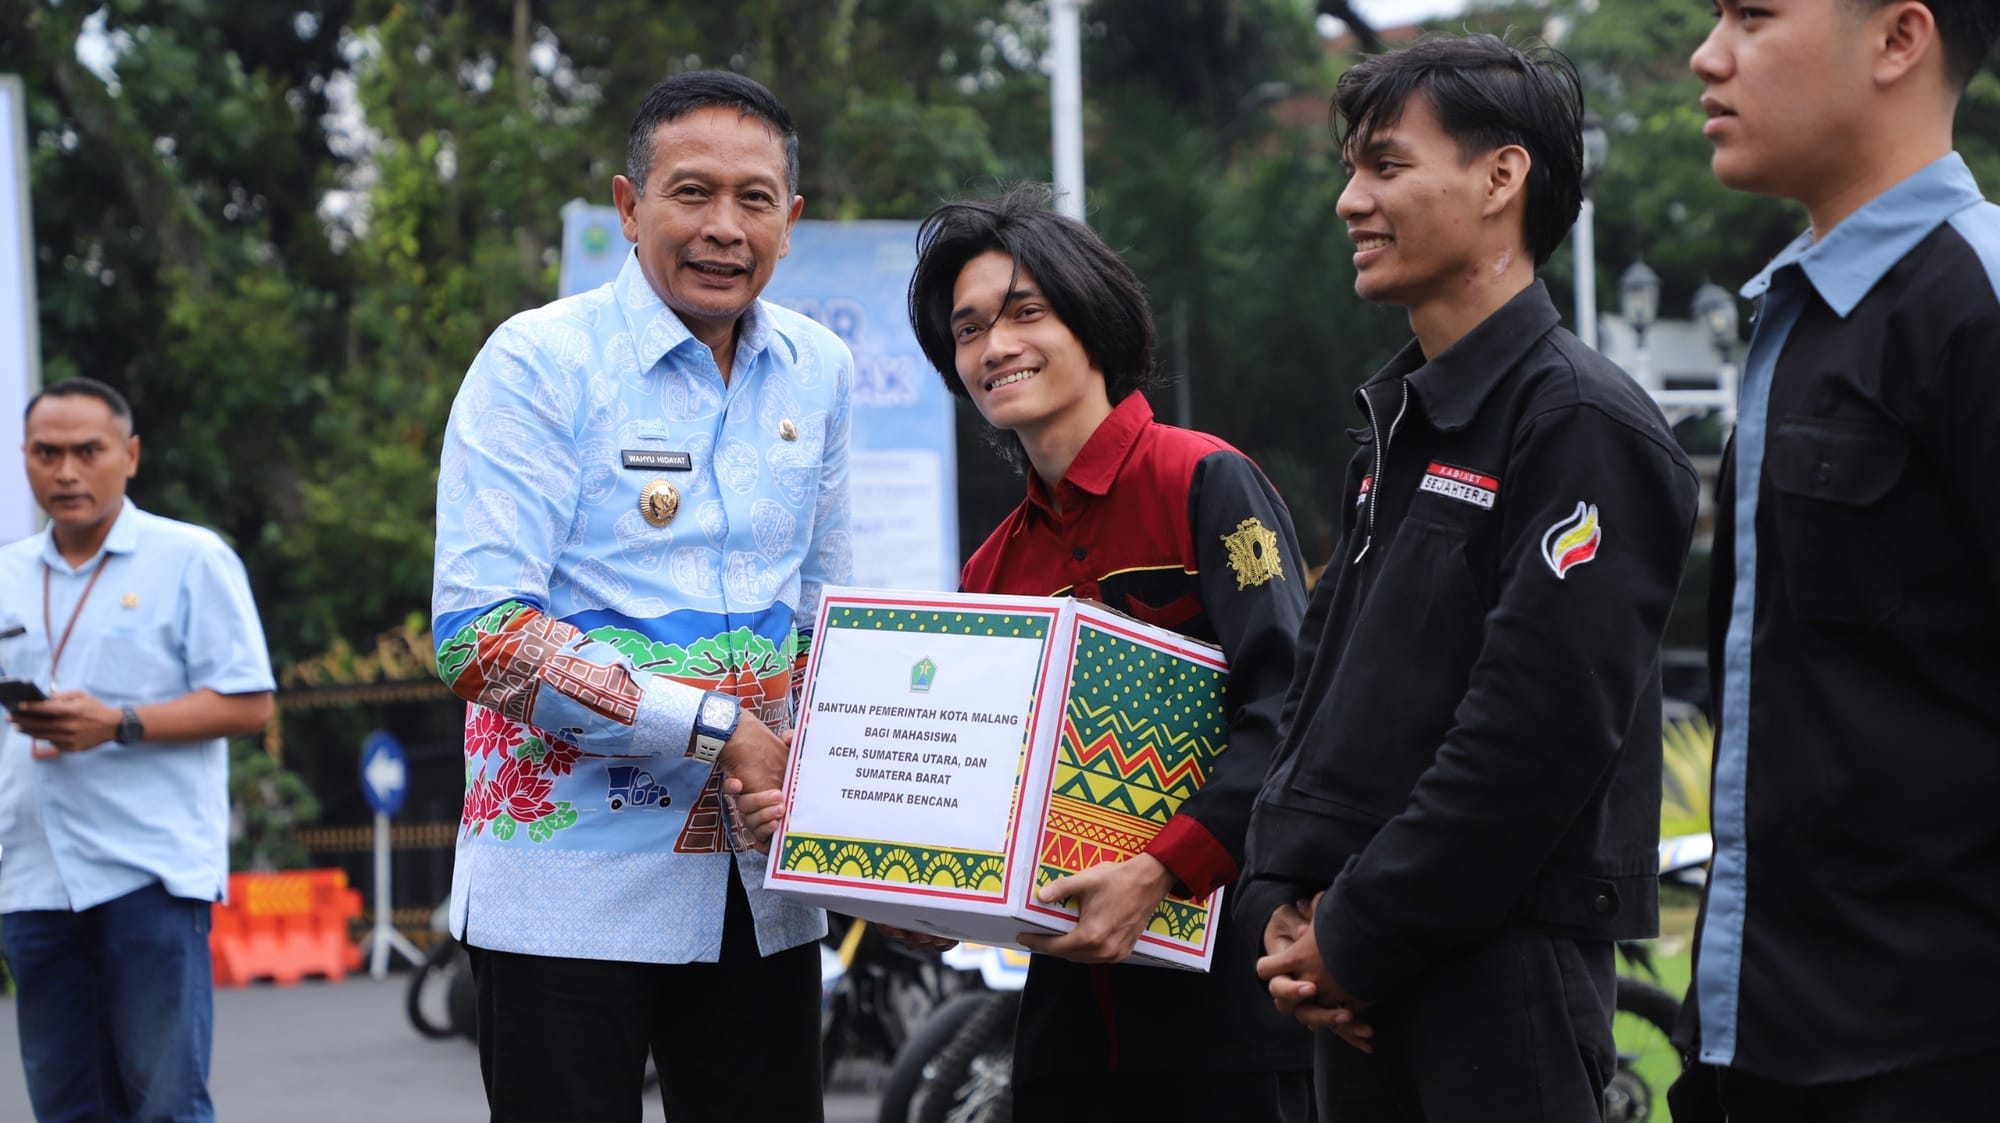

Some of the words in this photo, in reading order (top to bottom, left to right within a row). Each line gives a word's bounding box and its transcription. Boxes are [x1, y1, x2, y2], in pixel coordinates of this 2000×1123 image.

[628, 455, 655, 464] WAHYU
[657, 456, 685, 465] HIDAYAT
[1439, 467, 1482, 484] KABINET
[1425, 477, 1490, 505] SEJAHTERA
[817, 702, 867, 715] BANTUAN
[868, 705, 937, 720] PEMERINTAH
[939, 709, 968, 722] KOTA
[971, 712, 1019, 726] MALANG
[864, 726, 890, 739] BAGI
[892, 728, 957, 744] MAHASISWA
[828, 746, 859, 760] ACEH,
[861, 748, 919, 763] SUMATERA
[922, 753, 961, 767] UTARA,
[964, 756, 988, 769] DAN
[855, 767, 913, 782] SUMATERA
[915, 772, 952, 785] BARAT
[840, 788, 904, 804] TERDAMPAK
[906, 793, 959, 809] BENCANA
